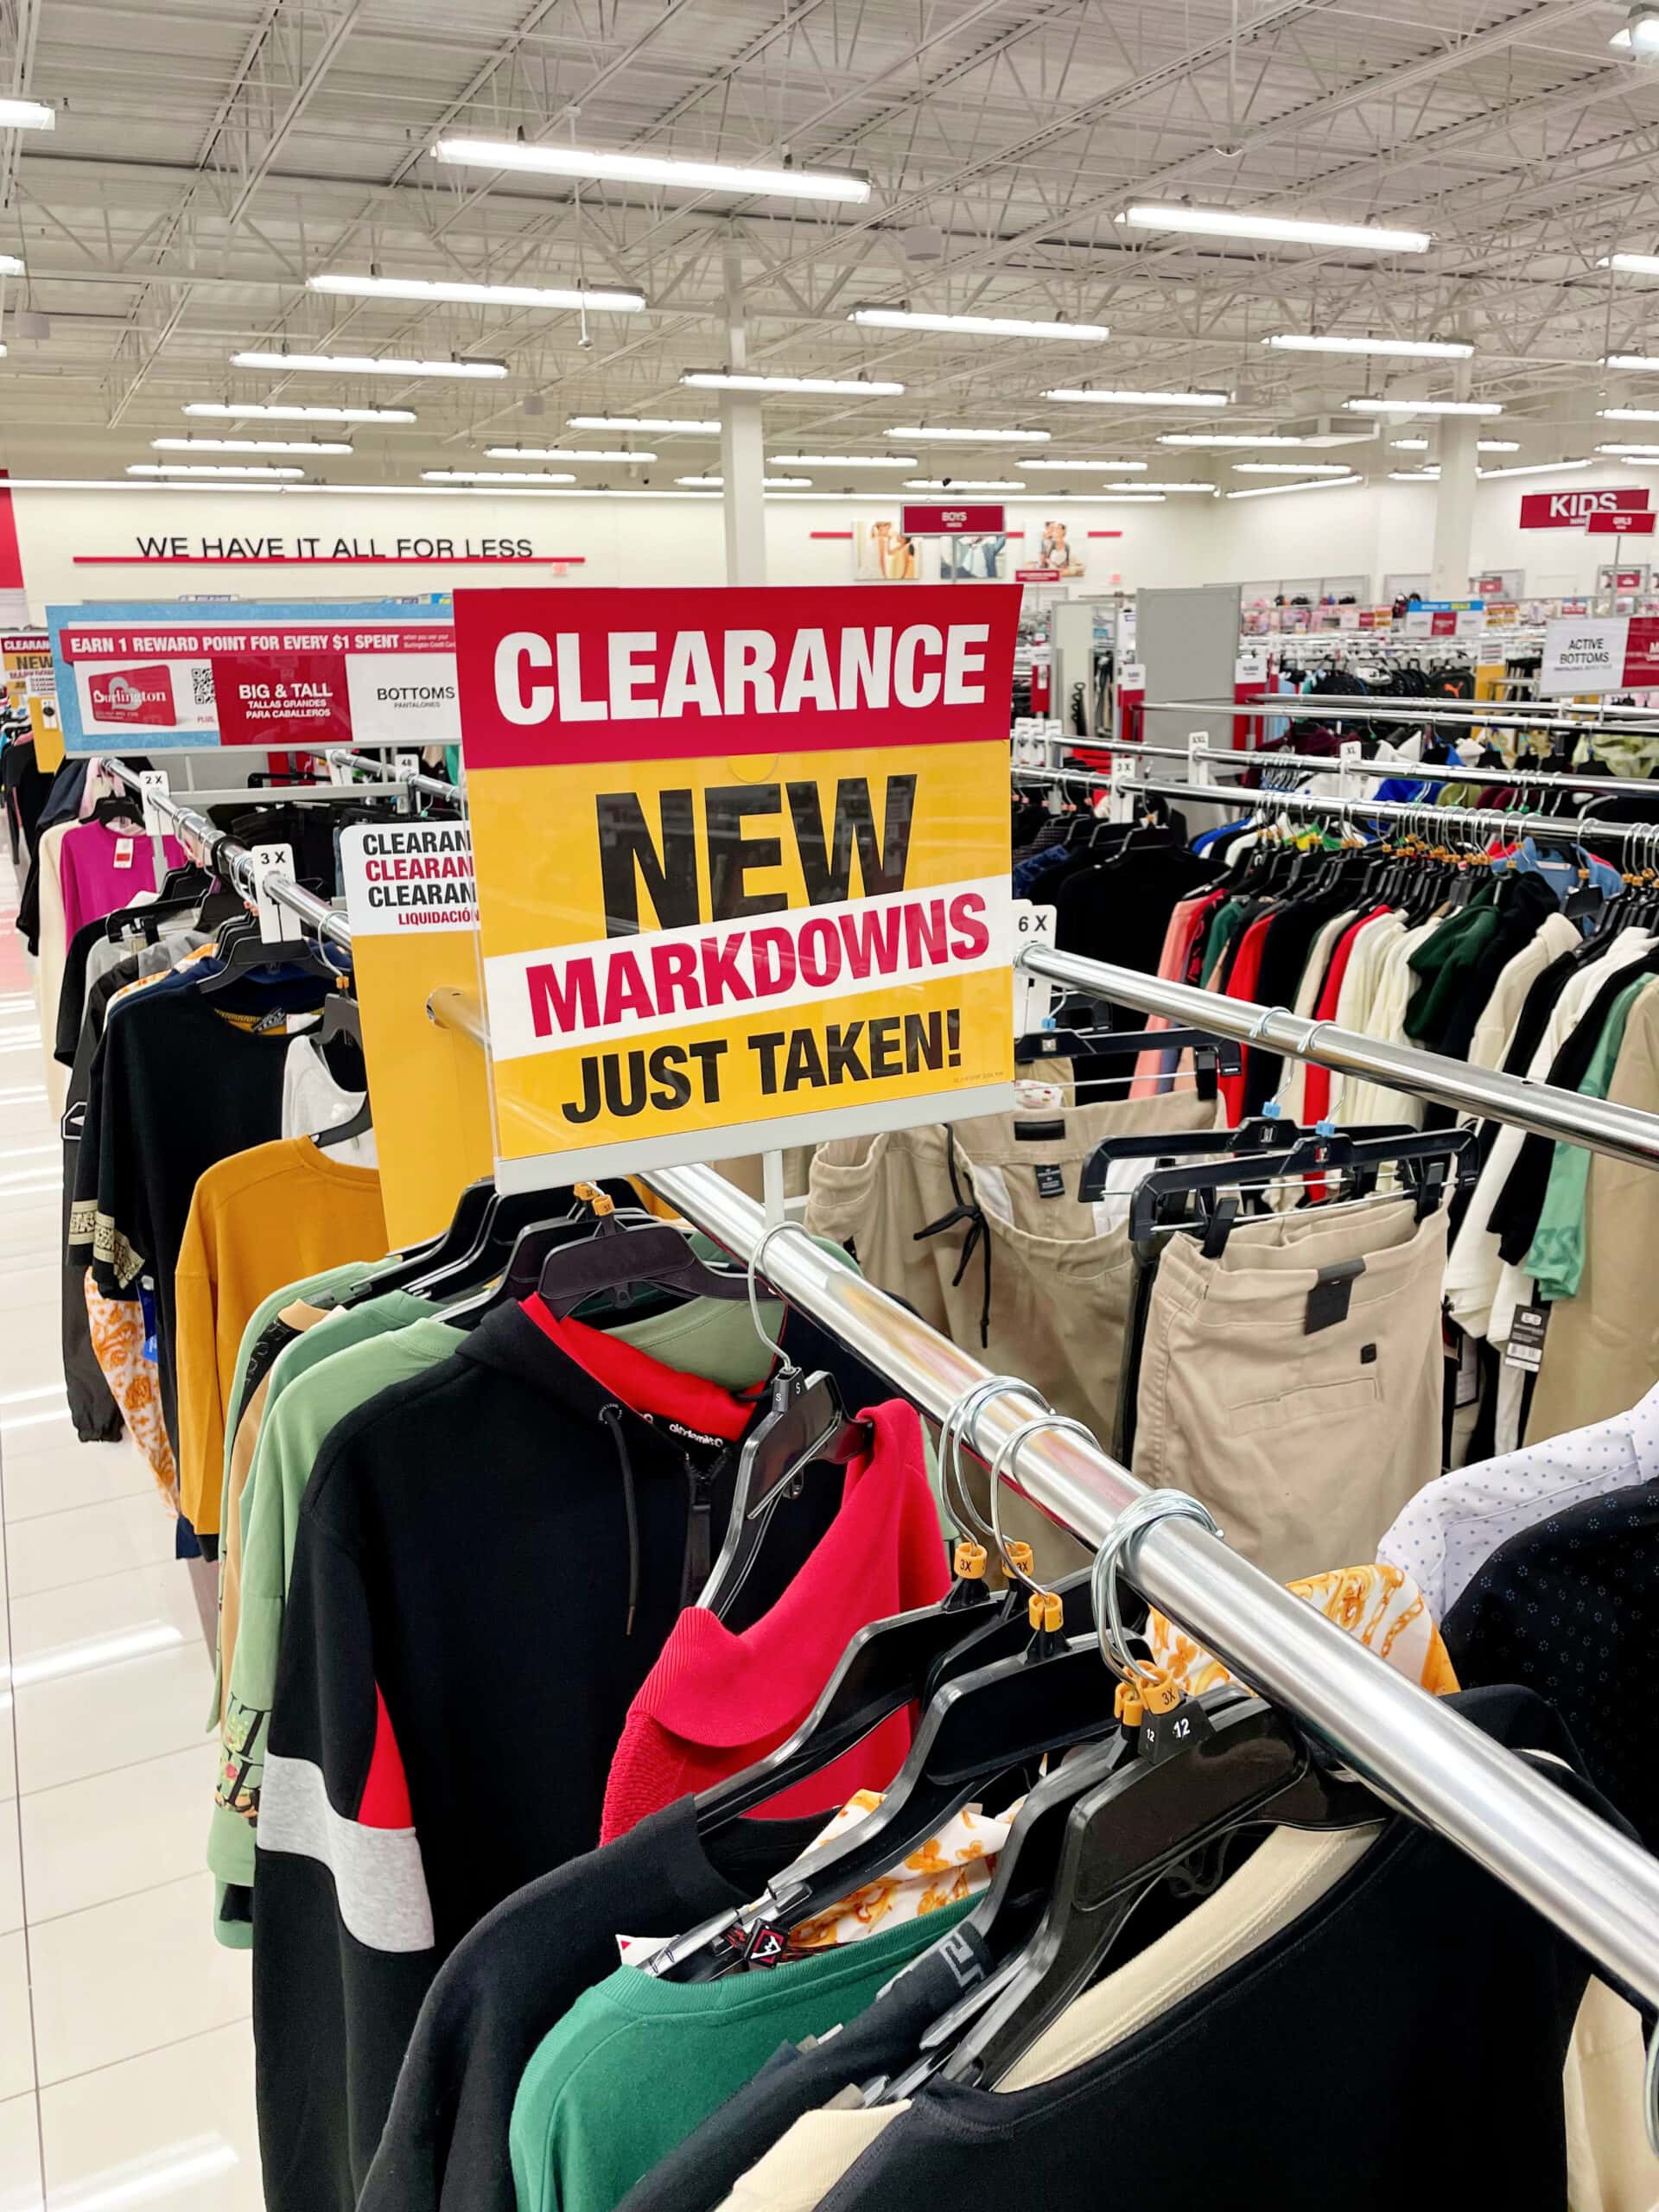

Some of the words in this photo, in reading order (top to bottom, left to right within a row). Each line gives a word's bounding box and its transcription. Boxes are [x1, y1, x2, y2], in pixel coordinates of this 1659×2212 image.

[1550, 493, 1618, 517] KIDS
[941, 512, 967, 521] BOYS
[137, 537, 189, 557] WE
[202, 537, 285, 558] HAVE
[297, 537, 320, 558] IT
[333, 538, 385, 558] ALL
[397, 538, 454, 558] FOR
[466, 539, 533, 558] LESS
[70, 638, 114, 653] EARN
[118, 637, 127, 652] 1
[132, 636, 198, 652] REWARD
[202, 636, 246, 652] POINT
[251, 635, 280, 651] FOR
[283, 635, 328, 651] EVERY
[332, 633, 350, 652] $1
[354, 633, 399, 650] SPENT
[1568, 638, 1604, 650] ACTIVE
[16, 656, 53, 670] NEW
[1560, 652, 1609, 664] BOTTOMS
[494, 624, 989, 724] CLEARANCE
[238, 684, 270, 699] BIG
[275, 683, 287, 698] &
[290, 683, 334, 698] TALL
[377, 686, 455, 701] BOTTOMS
[248, 700, 282, 709] TALLAS
[283, 699, 327, 708] GRANDES
[246, 710, 270, 719] PARA
[273, 709, 331, 718] CABALLEROS
[363, 830, 472, 855] CLEARAN
[595, 774, 917, 939] NEW
[365, 855, 474, 881] CLEARAN
[368, 882, 477, 908] CLEARAN
[526, 893, 989, 1038] MARKDOWNS
[562, 1039, 728, 1123] JUST
[748, 1009, 961, 1095] TAKEN!
[795, 1382, 801, 1395] S
[775, 1393, 782, 1402] S
[960, 1559, 972, 1573] 3X
[1161, 1688, 1176, 1706] 3X
[1147, 1728, 1155, 1742] 12
[1173, 1718, 1191, 1738] 12
